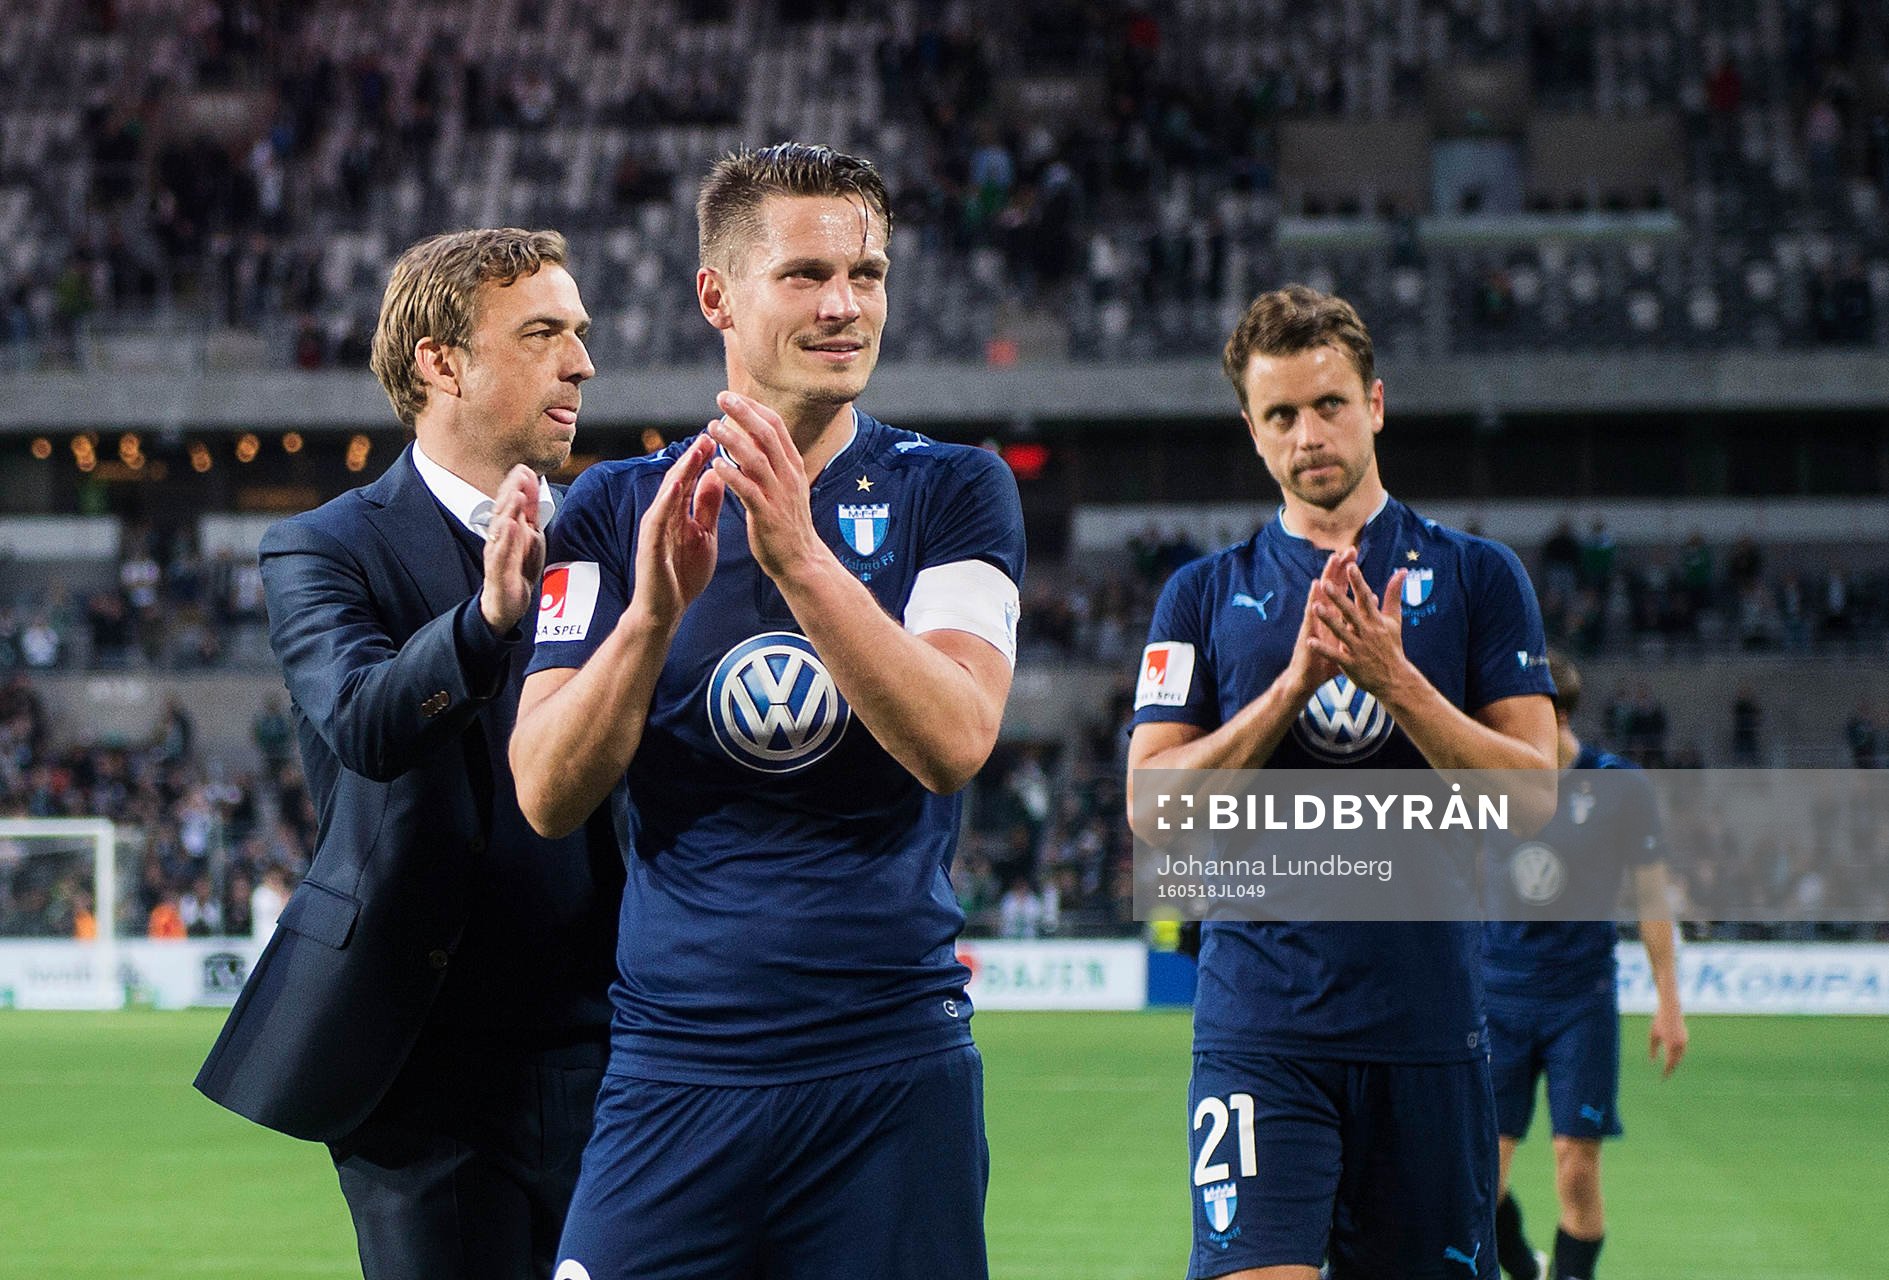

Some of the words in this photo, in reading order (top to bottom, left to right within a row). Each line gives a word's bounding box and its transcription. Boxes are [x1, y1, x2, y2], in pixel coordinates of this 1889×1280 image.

[553, 624, 582, 635] SPEL
[720, 645, 838, 760] VW
[1193, 1093, 1257, 1186] 21
